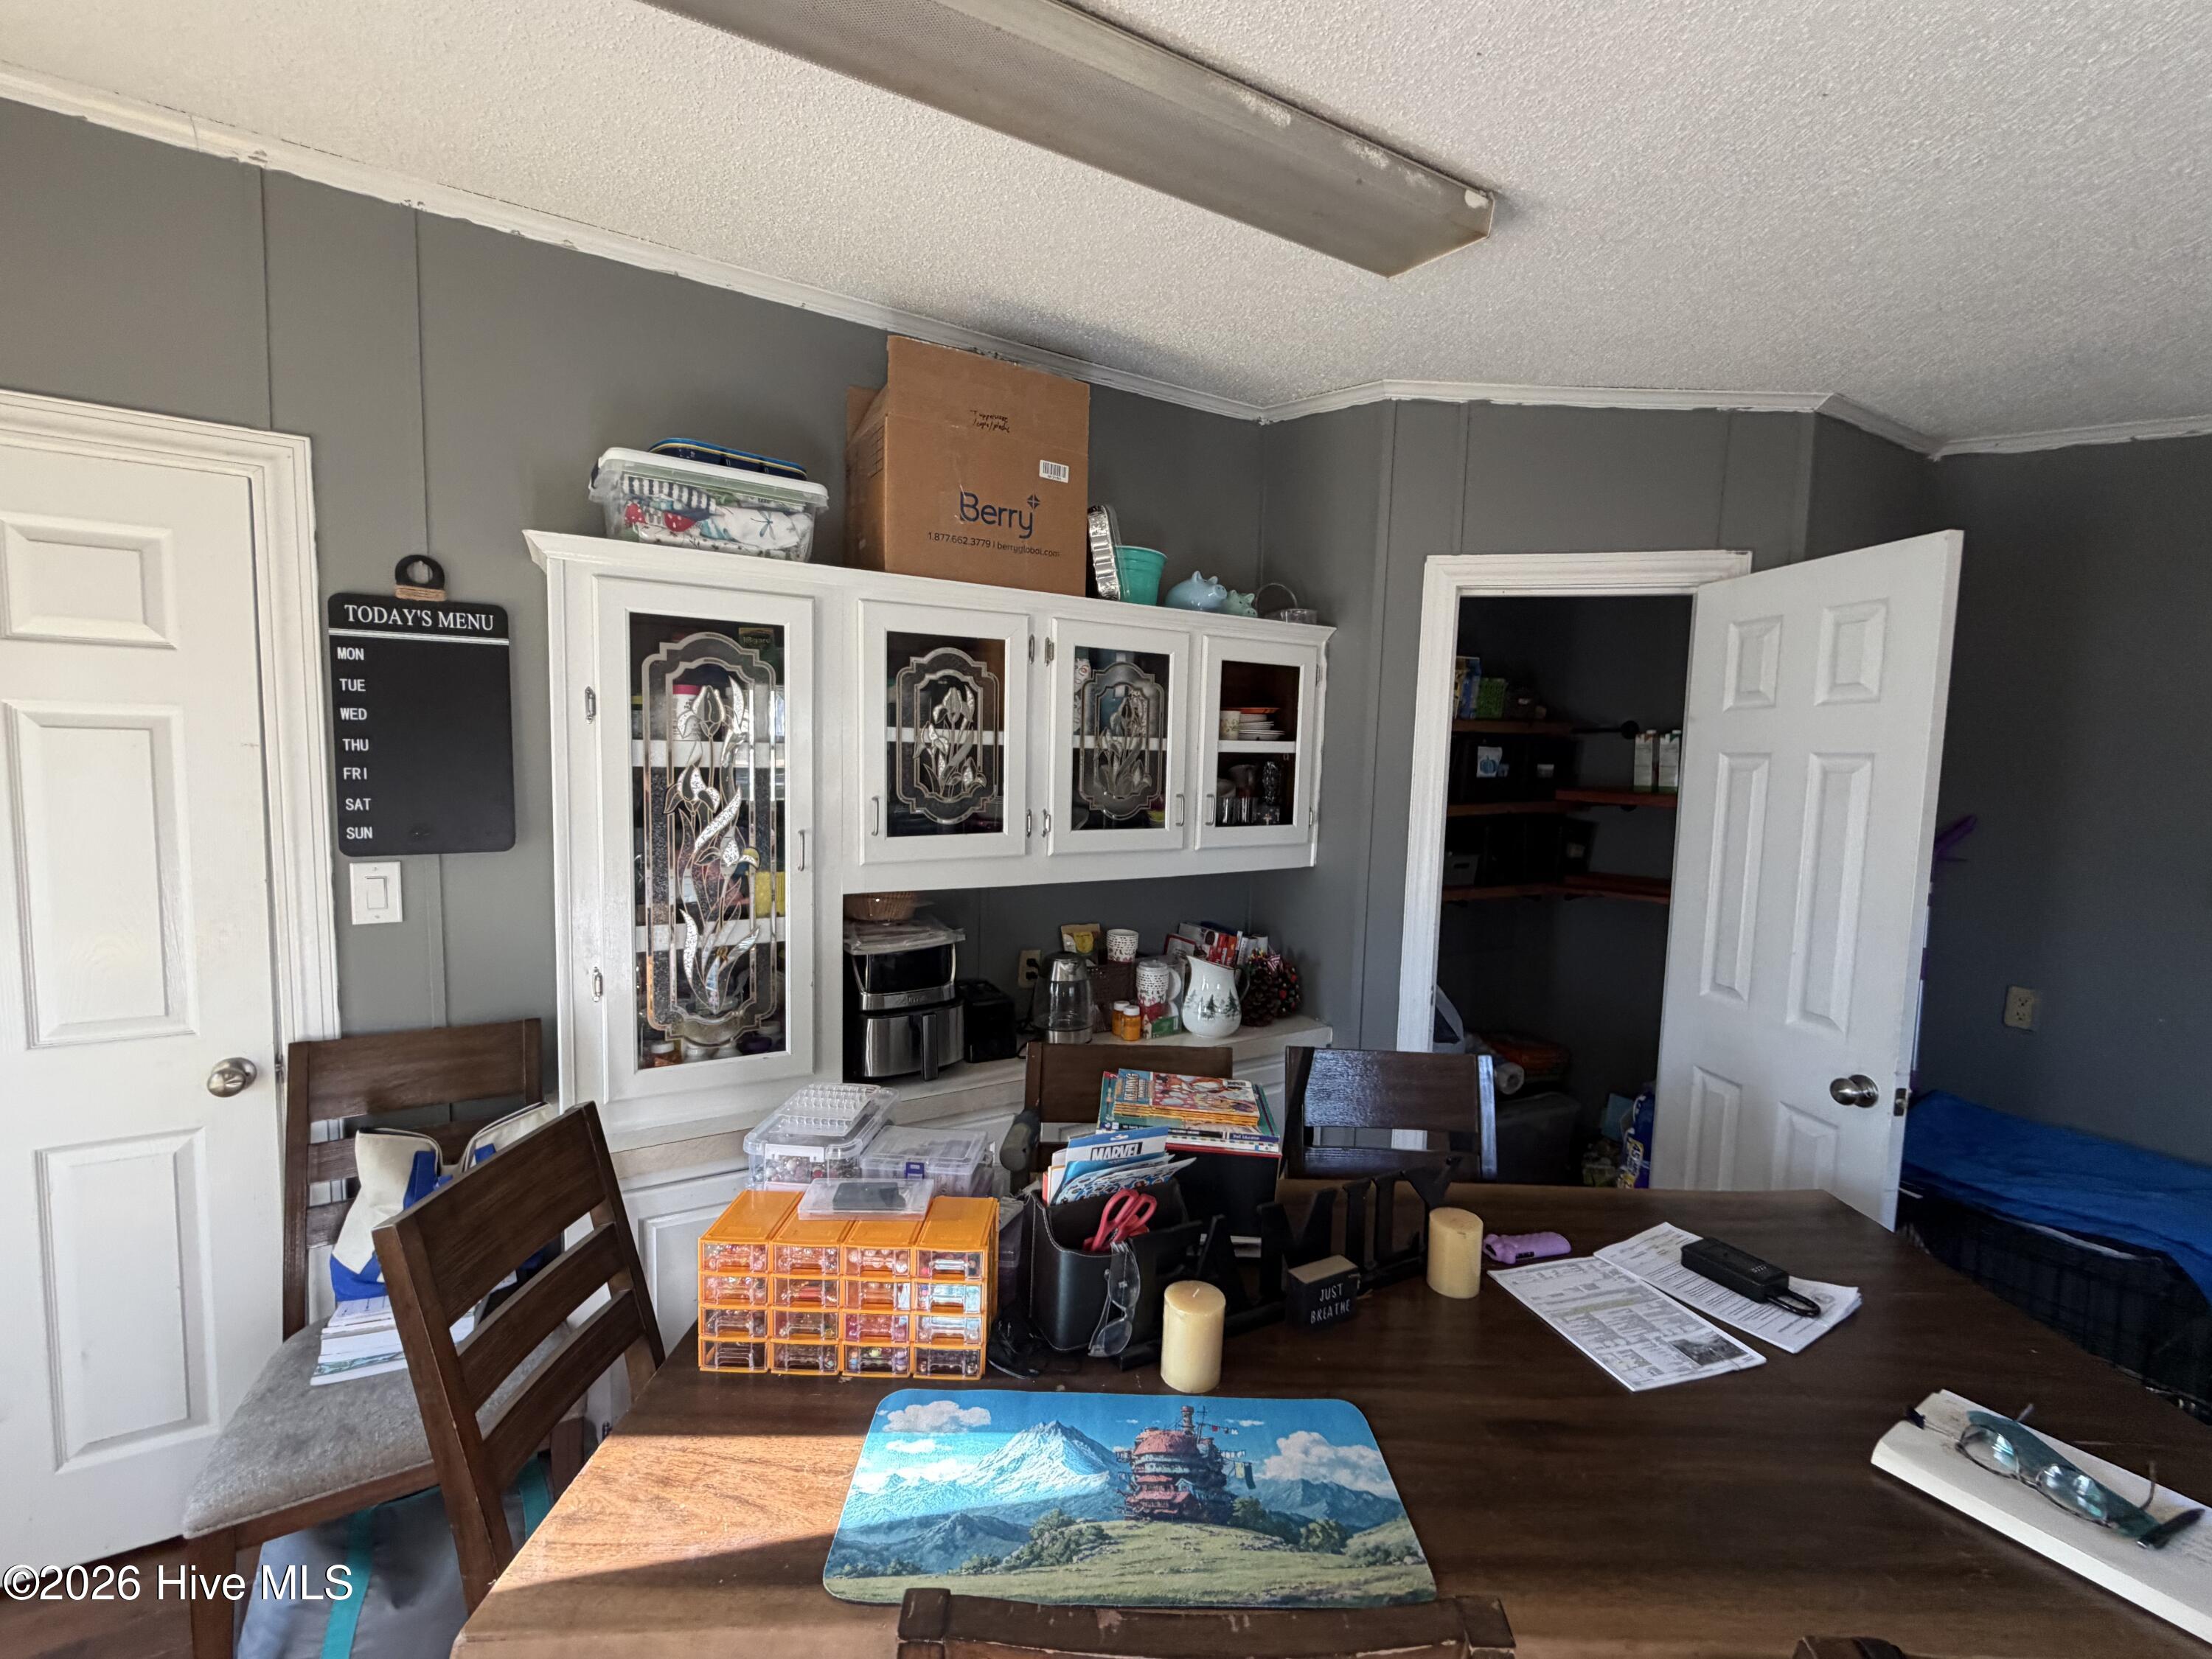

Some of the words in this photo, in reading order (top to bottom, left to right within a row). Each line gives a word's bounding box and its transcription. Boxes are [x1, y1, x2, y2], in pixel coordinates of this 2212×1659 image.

[959, 490, 1034, 539] Berry
[928, 532, 991, 549] 1.877.662.3779
[997, 542, 1060, 557] berryglobal.com
[344, 604, 432, 627] TODAY'S
[438, 611, 495, 631] MENU
[337, 647, 365, 661] MON
[339, 678, 366, 692] TUE
[340, 707, 368, 721] WED
[342, 737, 369, 752] THU
[343, 767, 368, 781] FRI
[345, 798, 372, 812] SAT
[346, 826, 373, 840] SUN
[1092, 1143, 1140, 1161] MARVEL
[1319, 1282, 1344, 1302] JUST
[1310, 1298, 1351, 1324] BREATHE
